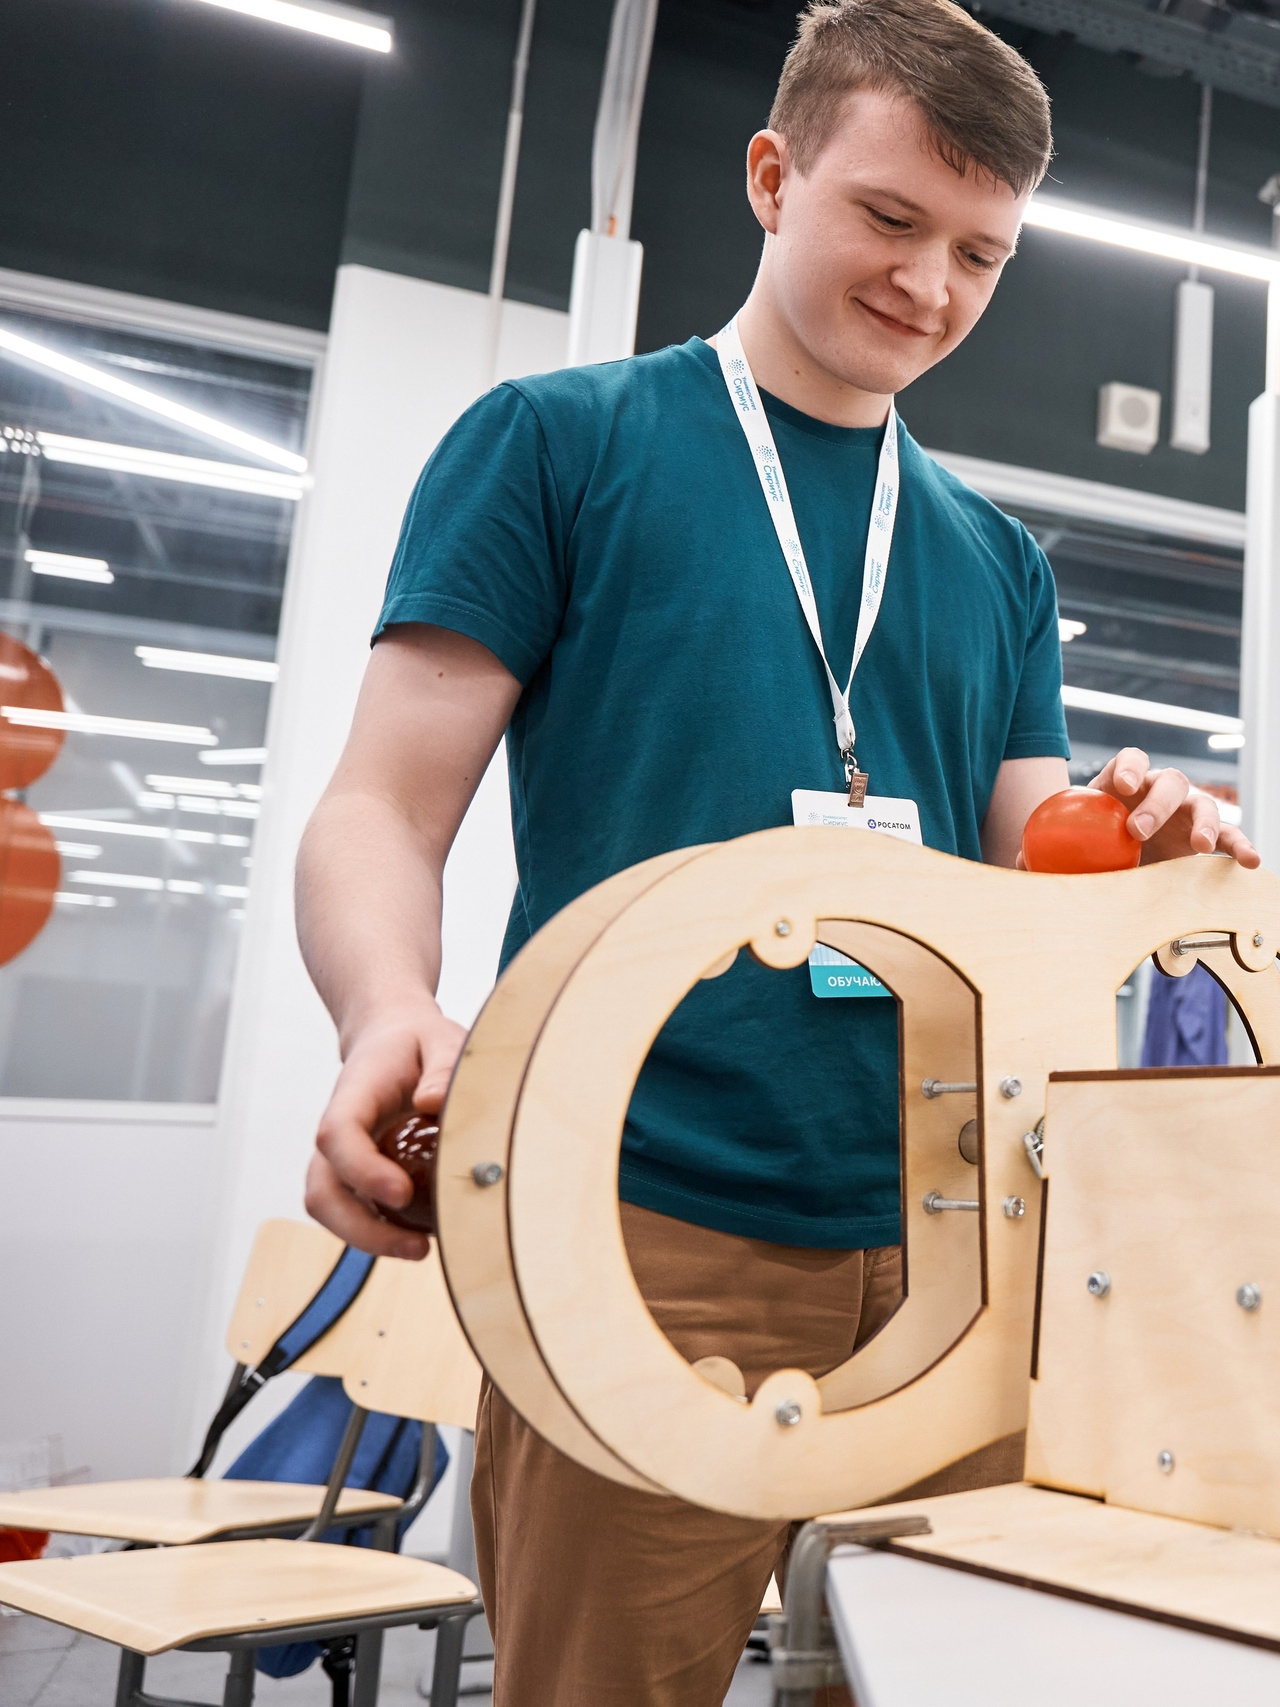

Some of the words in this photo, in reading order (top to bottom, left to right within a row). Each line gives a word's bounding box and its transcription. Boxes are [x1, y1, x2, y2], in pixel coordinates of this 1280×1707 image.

[733, 377, 750, 412] Сириус
[763, 464, 779, 502] Сириус
[882, 485, 893, 516] Сириус
[822, 818, 849, 827] Сириус
[877, 821, 911, 830] РОСАТОМ
[827, 976, 882, 987] ОБУЧАЮ
